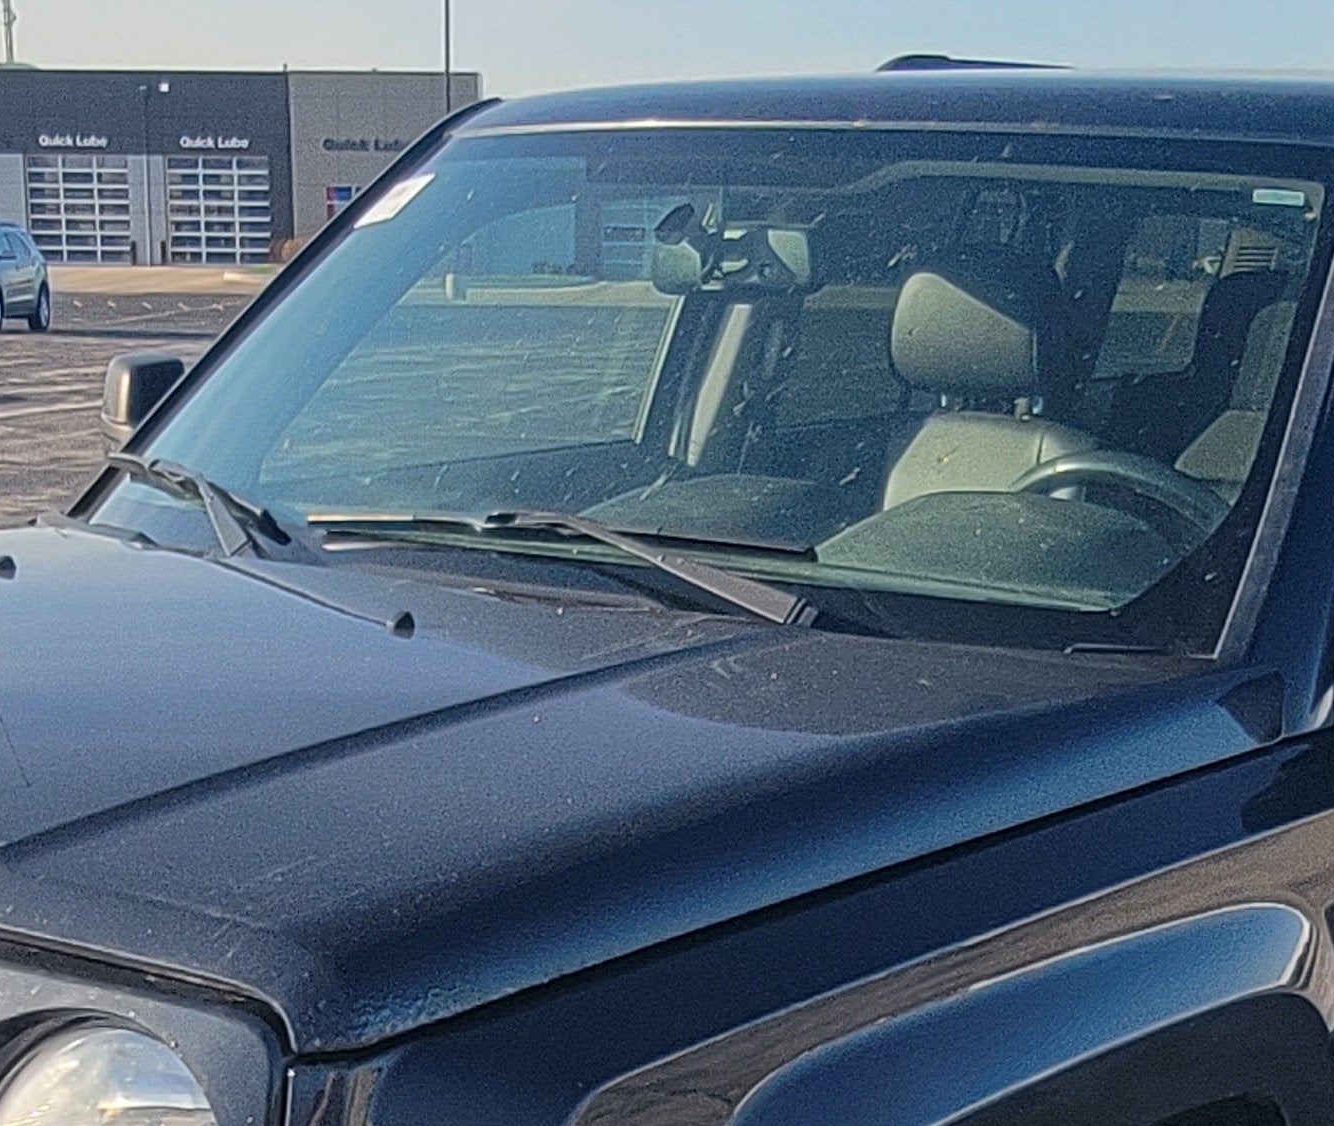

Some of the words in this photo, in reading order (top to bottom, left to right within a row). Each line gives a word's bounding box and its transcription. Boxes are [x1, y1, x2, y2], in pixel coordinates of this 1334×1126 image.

[38, 134, 74, 147] Quick
[76, 134, 109, 148] Lube
[179, 135, 216, 149] Quick
[218, 135, 251, 149] Lube
[322, 138, 370, 152] Quick
[374, 138, 409, 152] Lub
